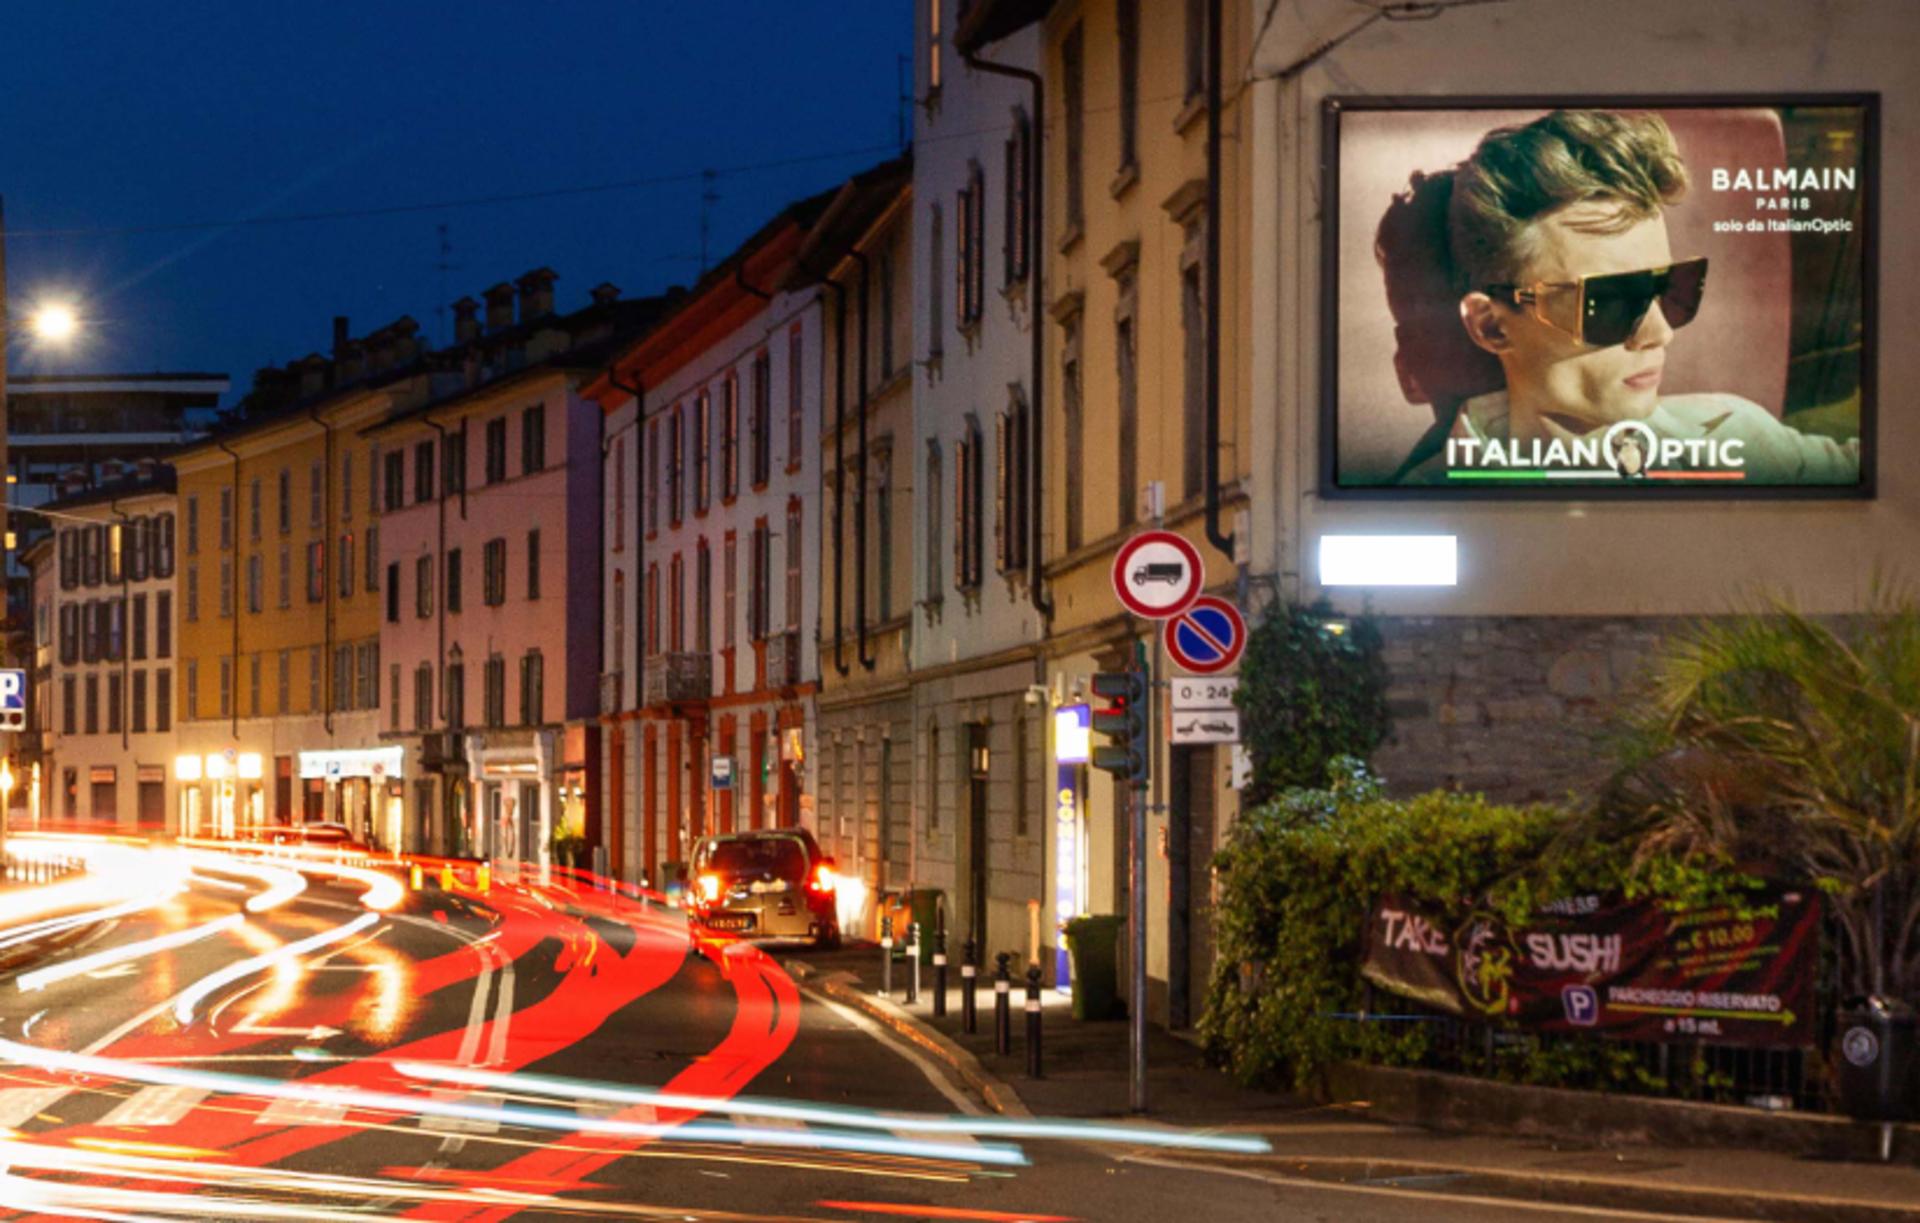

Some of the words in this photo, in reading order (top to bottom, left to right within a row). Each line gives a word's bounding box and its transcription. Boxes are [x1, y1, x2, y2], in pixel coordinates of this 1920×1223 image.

[1712, 168, 1856, 191] BALMAIN
[1756, 198, 1811, 210] PARIS
[1713, 219, 1743, 232] solo
[1745, 219, 1764, 232] da
[1767, 218, 1854, 234] ItalianOptic
[1181, 686, 1192, 699] 0
[1207, 686, 1229, 699] 24
[1381, 908, 1449, 955] TAKE
[1526, 933, 1622, 972] SUSHI
[1569, 991, 1590, 1018] P
[1608, 986, 1695, 1007] PARCHEGGIO
[1695, 990, 1781, 1012] RISERVATO
